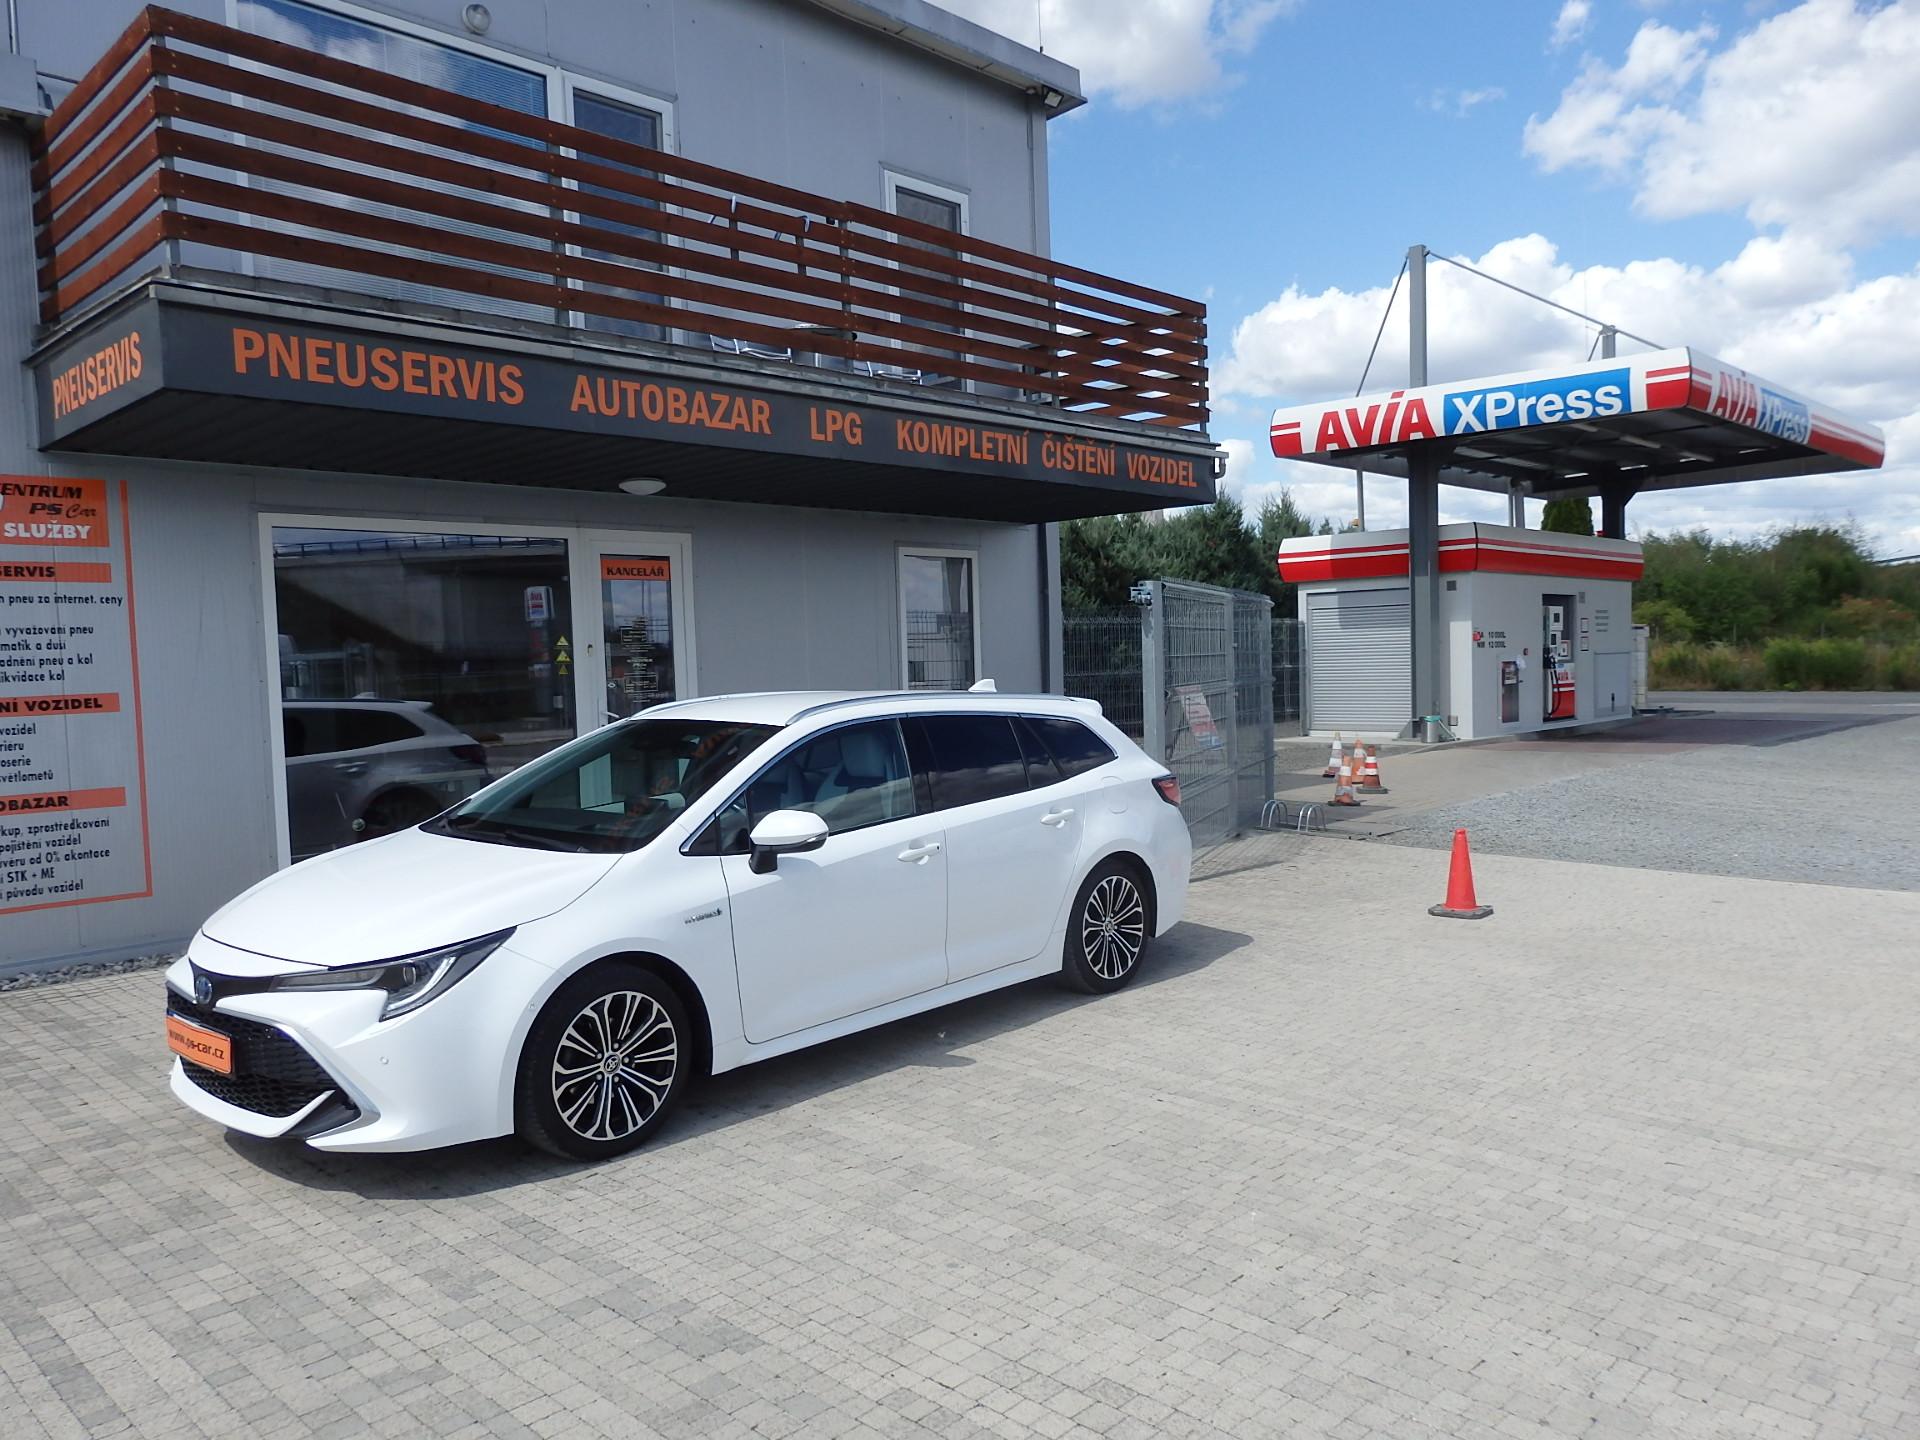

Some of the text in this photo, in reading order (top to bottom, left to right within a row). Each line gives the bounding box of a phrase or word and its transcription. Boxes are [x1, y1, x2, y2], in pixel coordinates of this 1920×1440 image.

[51, 330, 142, 420] PNEUSERVIS
[232, 327, 1197, 488] PNEUSERVIS AUTOBAZAR LPG KOMPLETNÍ ČIŠTĚNÍ VOZIDEL
[1446, 383, 1624, 435] XPress
[0, 482, 82, 499] ENTRUM
[29, 502, 63, 515] PS
[4, 520, 92, 539] SLUŽBY
[9, 595, 34, 607] pneu
[100, 595, 123, 607] ceny
[69, 626, 94, 637] pneu
[39, 657, 64, 668] pneu
[77, 654, 93, 665] kol
[49, 670, 65, 681] kol
[24, 697, 103, 712] VOZIDEL
[0, 824, 23, 839] kup,
[45, 833, 81, 848] vozidel
[30, 852, 42, 865] od
[45, 851, 60, 864] 0%
[64, 848, 111, 862] akontace
[7, 868, 28, 884] STK
[40, 867, 55, 879] ME
[47, 878, 84, 893] vozidel
